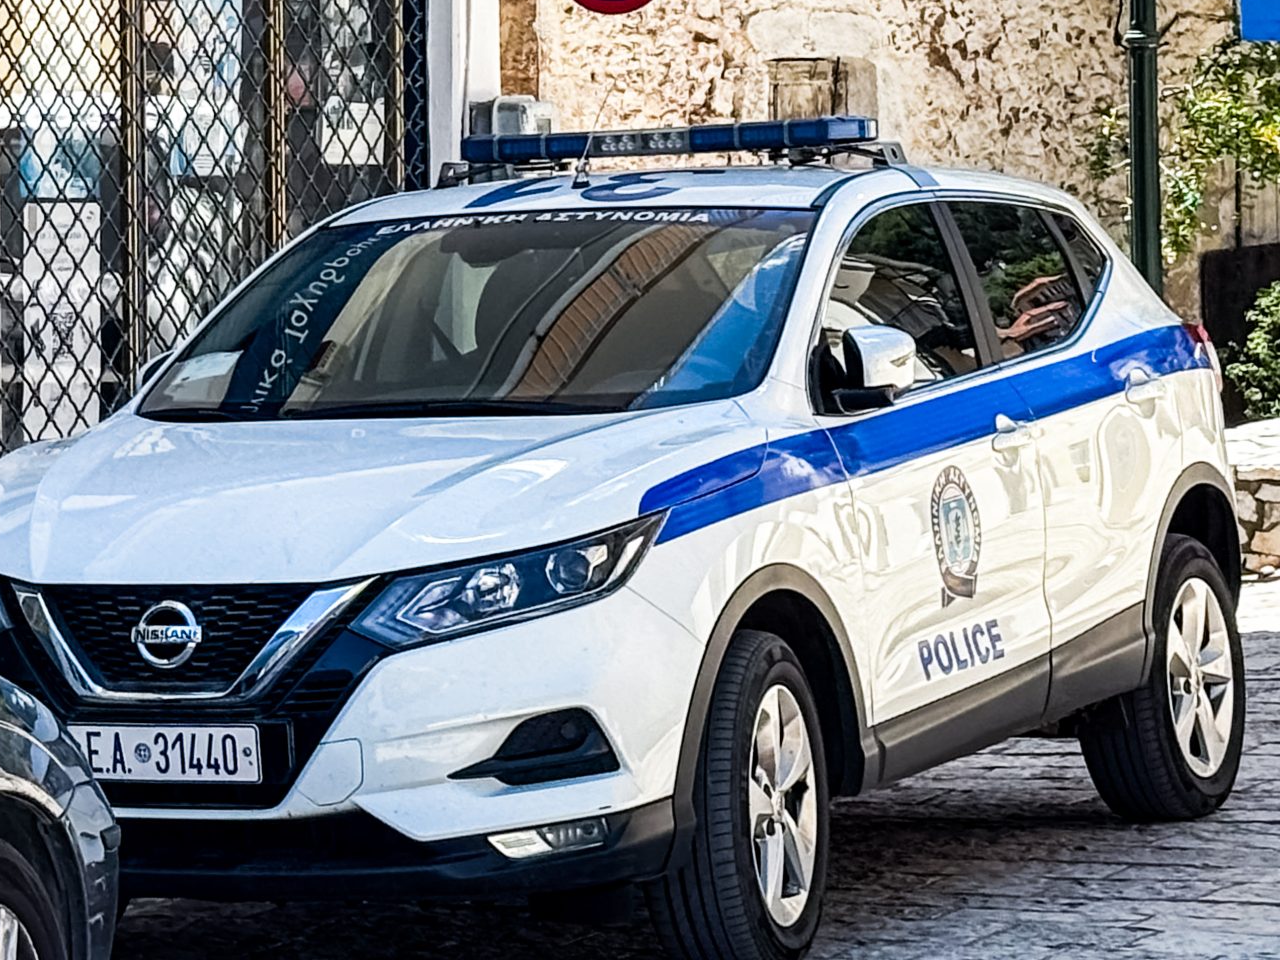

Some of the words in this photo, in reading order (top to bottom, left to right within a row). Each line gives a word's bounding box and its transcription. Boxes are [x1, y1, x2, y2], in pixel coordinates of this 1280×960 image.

[535, 211, 710, 223] ΑΣΤΥΝΟΜΙΑ
[134, 626, 194, 641] NISSAN
[917, 618, 1005, 682] POLICE
[153, 731, 239, 776] 31440
